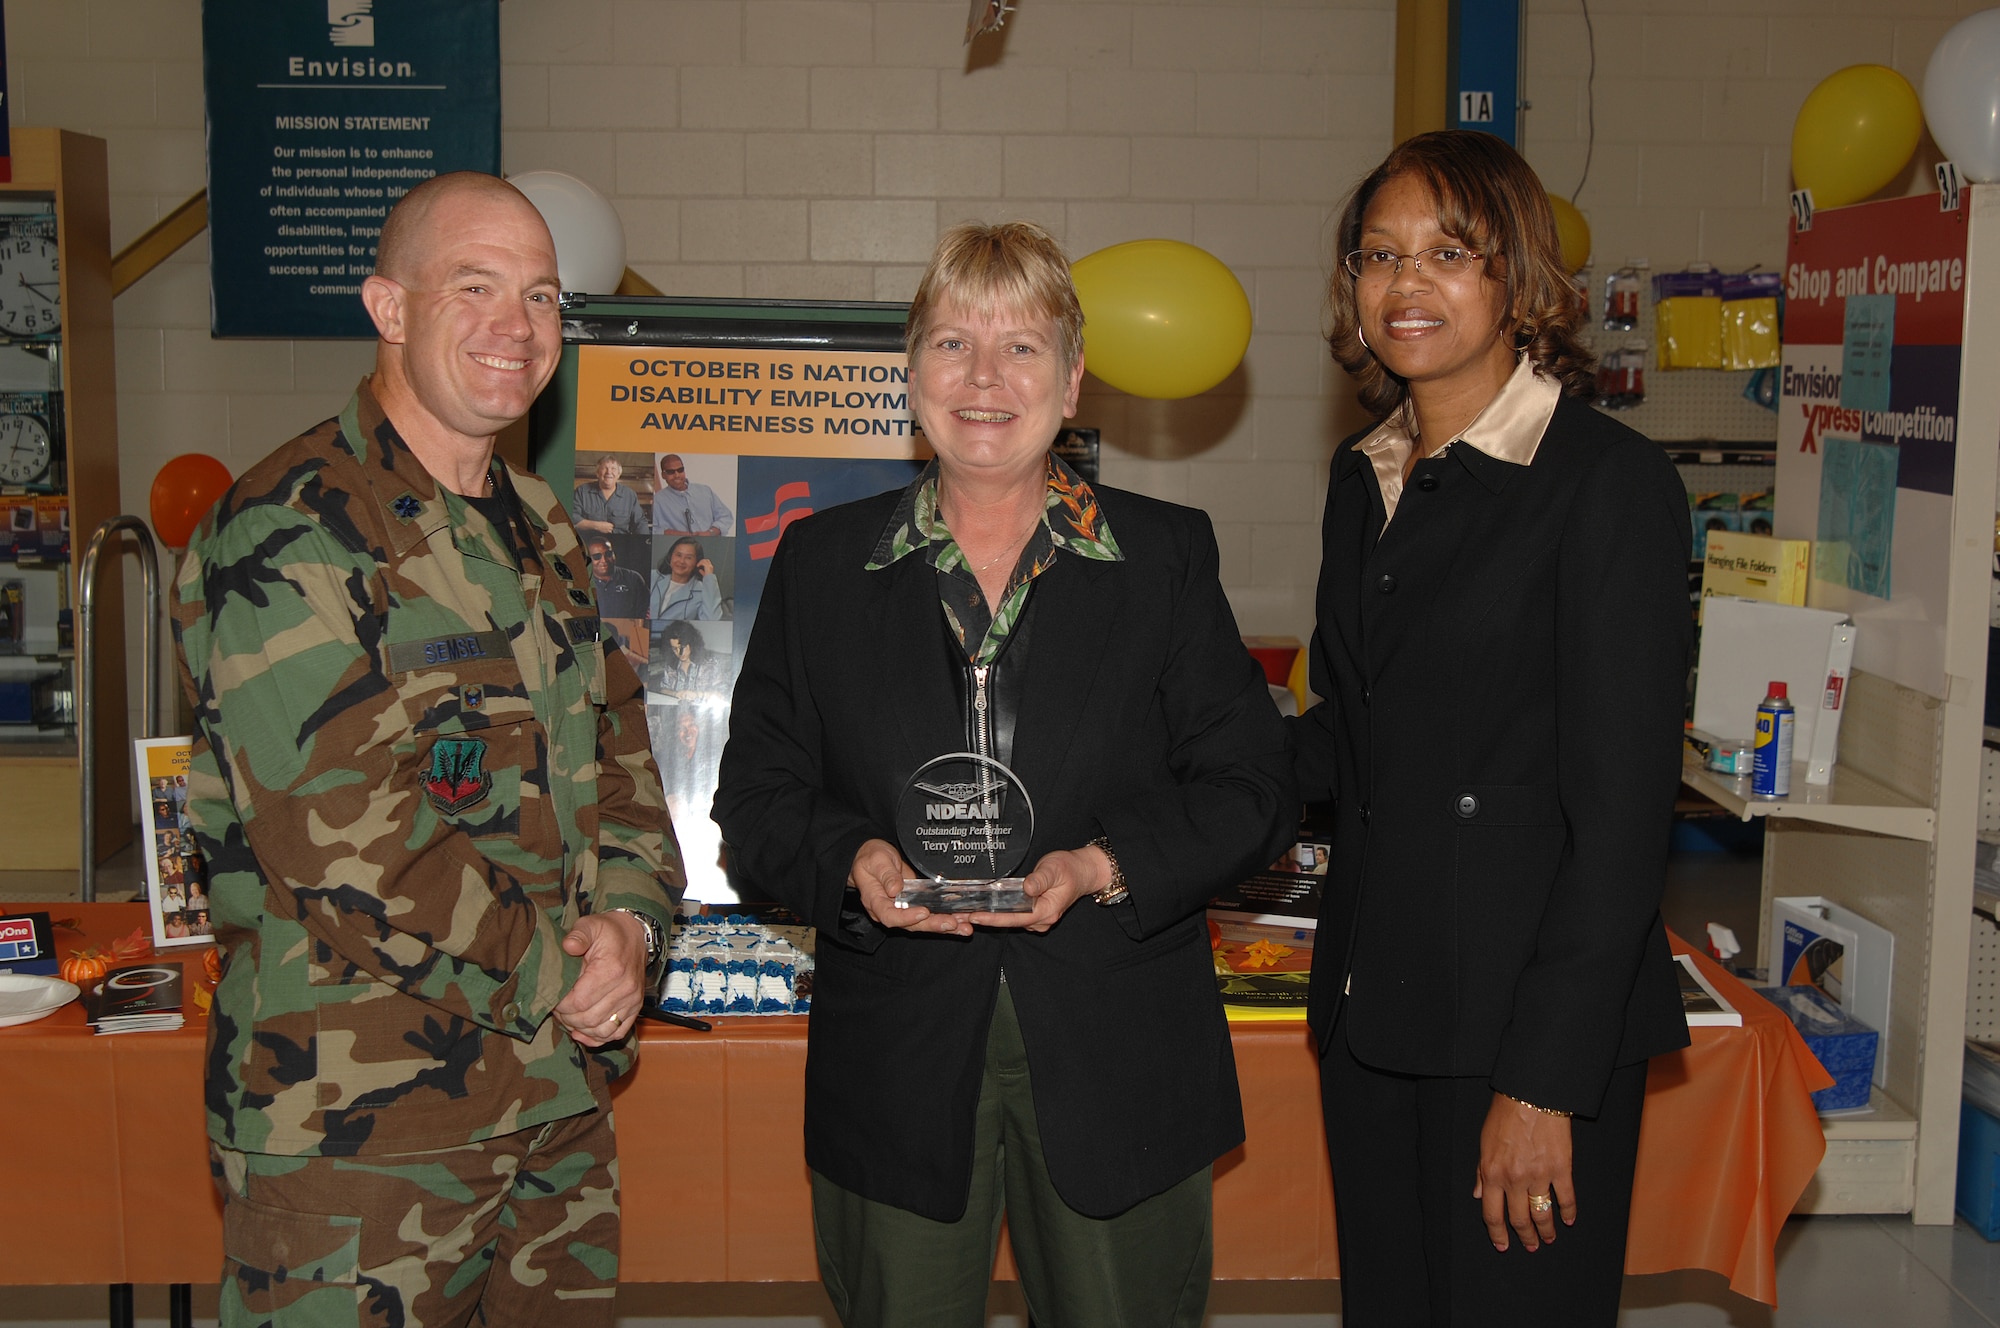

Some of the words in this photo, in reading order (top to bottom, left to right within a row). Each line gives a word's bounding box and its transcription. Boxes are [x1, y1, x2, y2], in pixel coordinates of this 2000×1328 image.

[289, 57, 412, 77] Envision
[1465, 94, 1490, 121] 1A
[276, 117, 339, 130] MISSION
[344, 117, 431, 130] STATEMENT
[274, 146, 295, 158] Our
[300, 147, 346, 158] mission
[350, 147, 360, 158] is
[365, 147, 378, 158] to
[382, 148, 434, 159] enhance
[272, 166, 292, 177] the
[296, 166, 348, 179] personal
[352, 167, 437, 180] independence
[260, 186, 272, 197] of
[276, 186, 340, 197] individuals
[344, 186, 383, 198] whose
[1939, 163, 1958, 210] 3A
[270, 205, 300, 217] often
[305, 206, 386, 219] accompanied
[1792, 191, 1811, 231] 2A
[278, 225, 348, 237] disabilities,
[264, 244, 345, 257] opportunities
[348, 245, 365, 256] for
[269, 265, 319, 275] success
[323, 264, 345, 275] and
[1787, 263, 1831, 307] Shop
[1835, 256, 1869, 298] and
[1874, 254, 1962, 303] Compare
[629, 359, 760, 380] OCTOBER
[770, 363, 793, 381] IS
[803, 364, 909, 384] NATION
[610, 385, 762, 406] DISABILITY
[770, 390, 908, 411] EMPLOYM
[640, 413, 814, 435] AWARENESS
[824, 418, 930, 438] MONTH
[1800, 403, 1861, 454] Xpress
[1863, 405, 1954, 444] Competition
[1736, 557, 1748, 570] File
[1749, 560, 1777, 574] Folders
[424, 636, 487, 664] SEMSEL
[925, 803, 1000, 820] NDEAM
[915, 826, 968, 838] Outstanding
[922, 840, 950, 853] Terry
[953, 855, 977, 864] 2007
